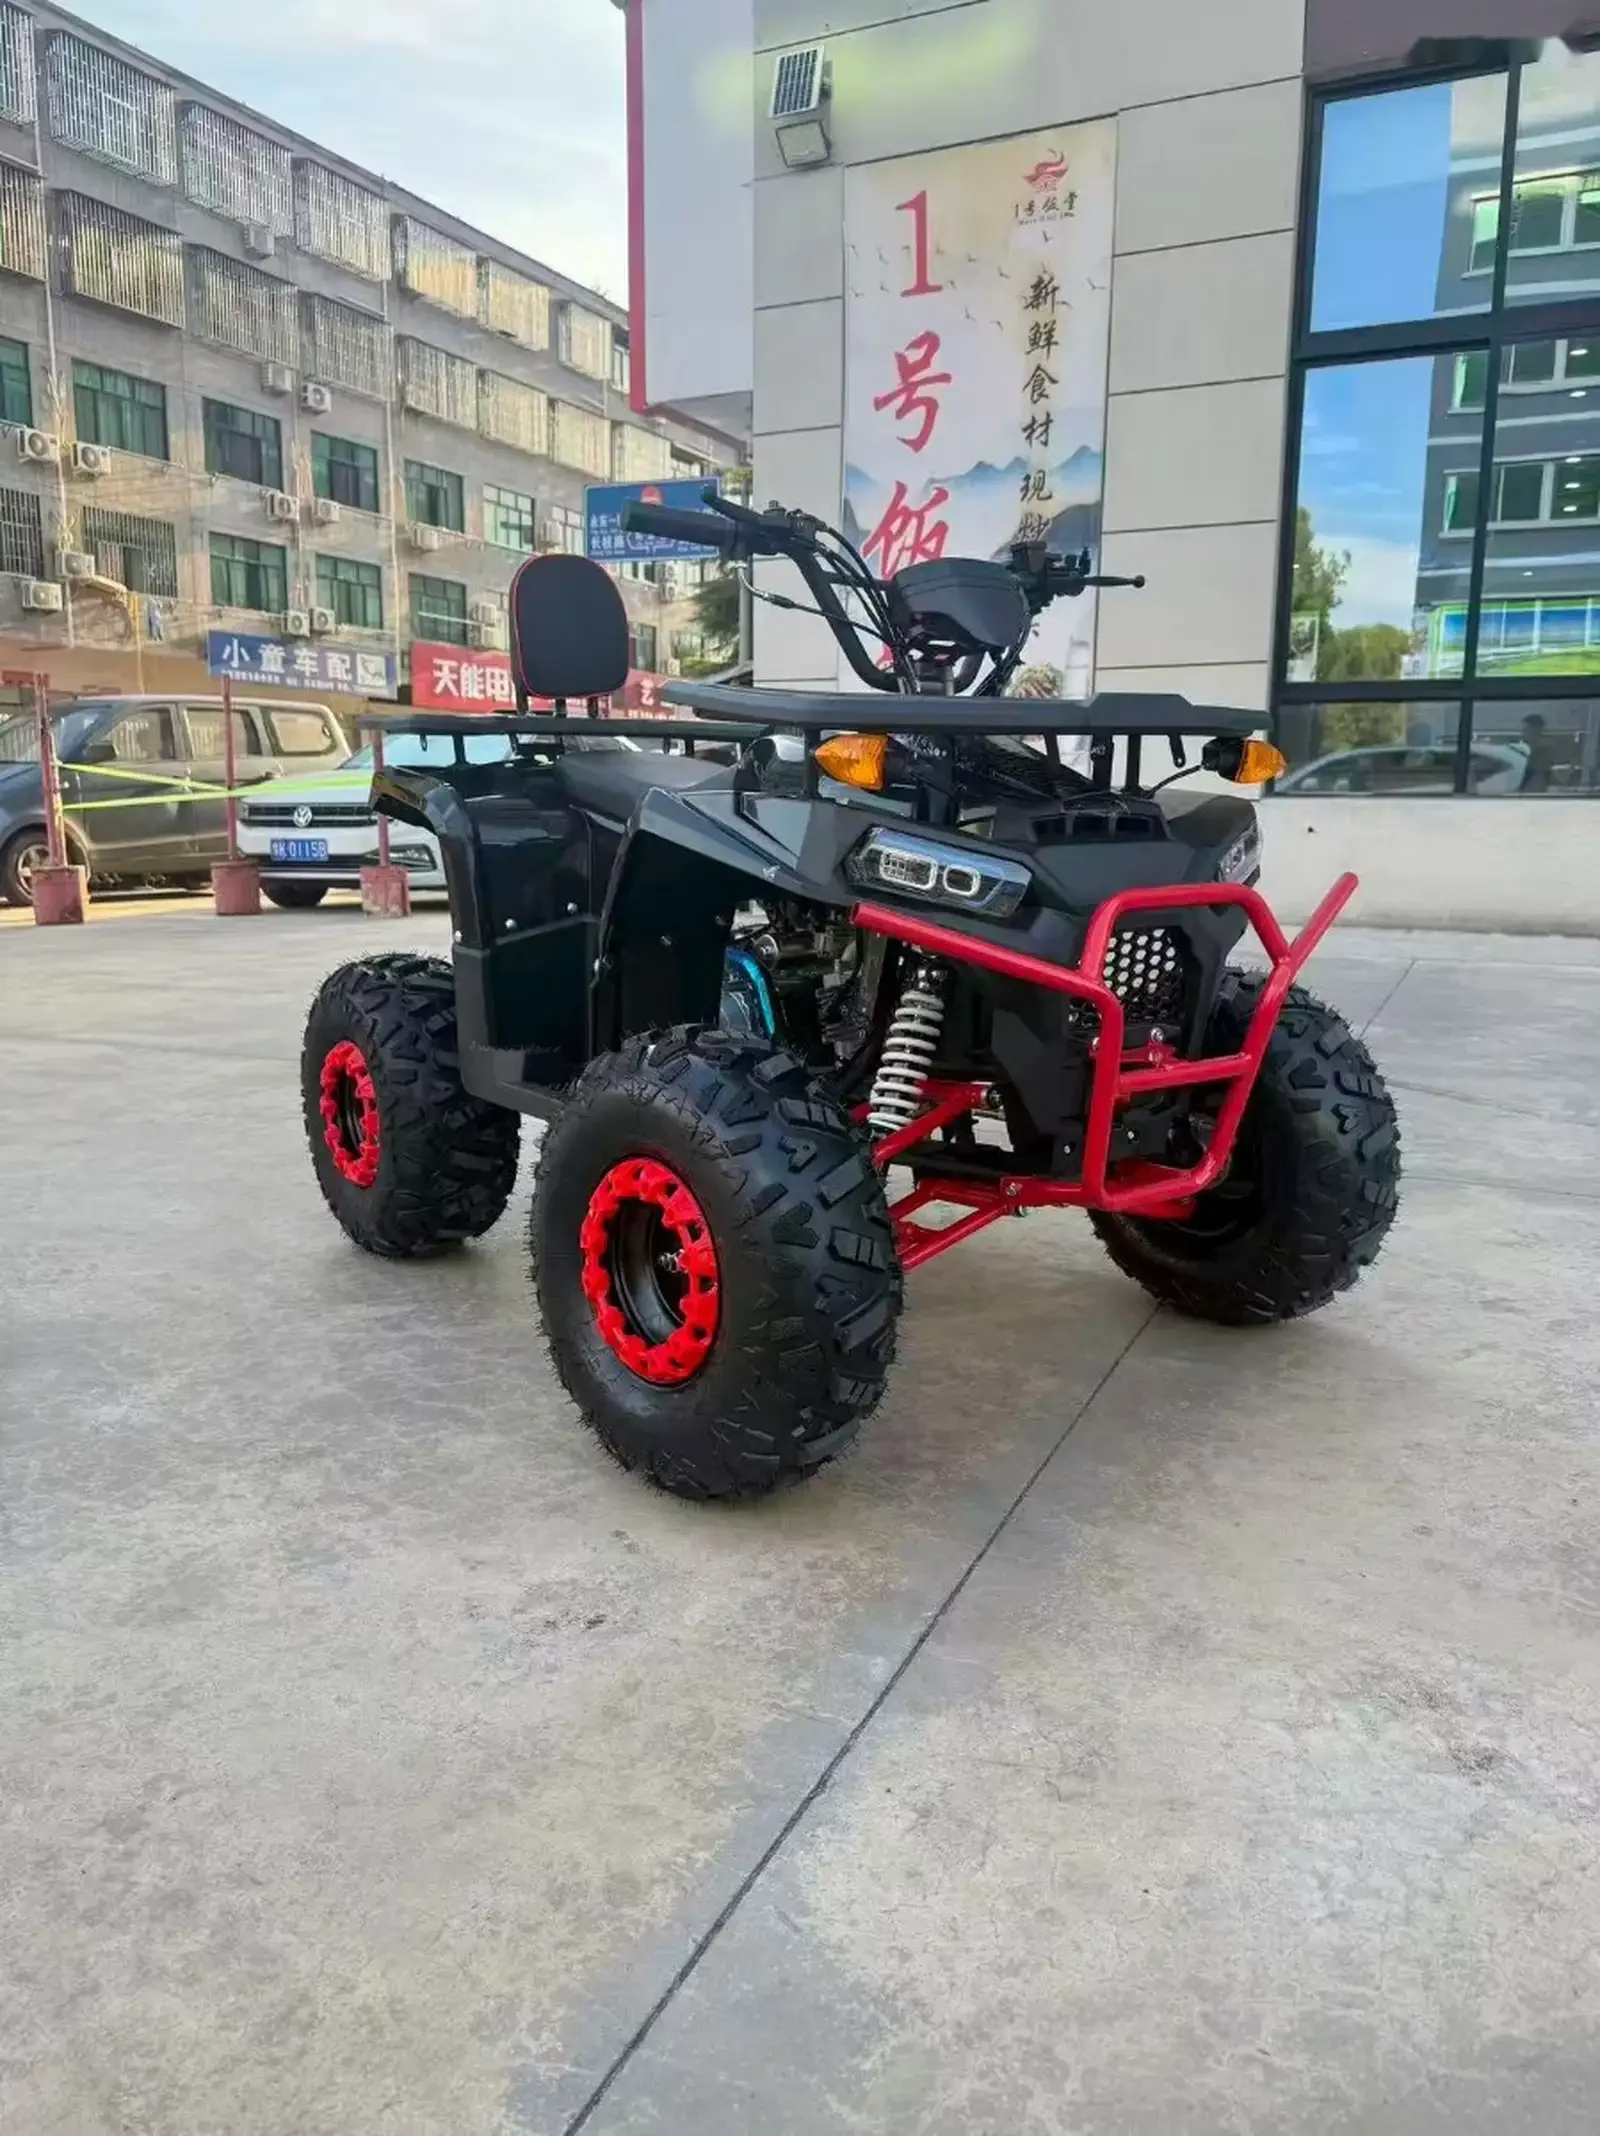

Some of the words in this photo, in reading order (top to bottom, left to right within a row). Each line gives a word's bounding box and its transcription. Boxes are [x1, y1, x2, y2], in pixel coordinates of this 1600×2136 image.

[863, 189, 952, 572] 1号饭
[433, 658, 517, 703] 天能电
